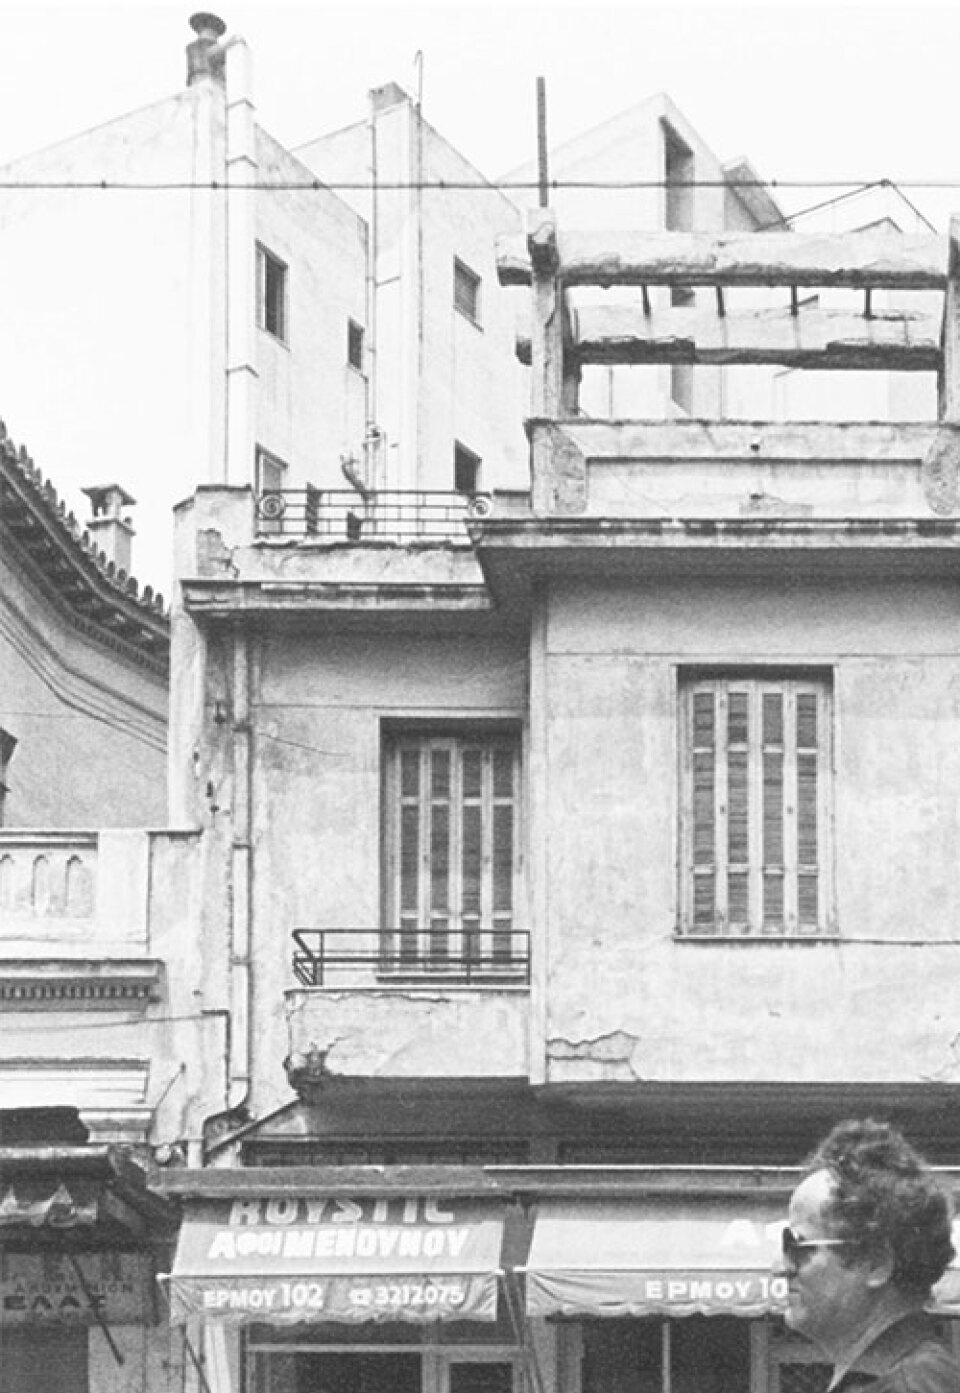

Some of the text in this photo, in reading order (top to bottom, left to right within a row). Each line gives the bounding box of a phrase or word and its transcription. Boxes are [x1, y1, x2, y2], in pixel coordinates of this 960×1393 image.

[203, 1283, 466, 1309] ΕΡΜΟΥ 102 3212075
[645, 1279, 752, 1299] ΕΡΜΟΥ
[760, 1277, 789, 1299] 10
